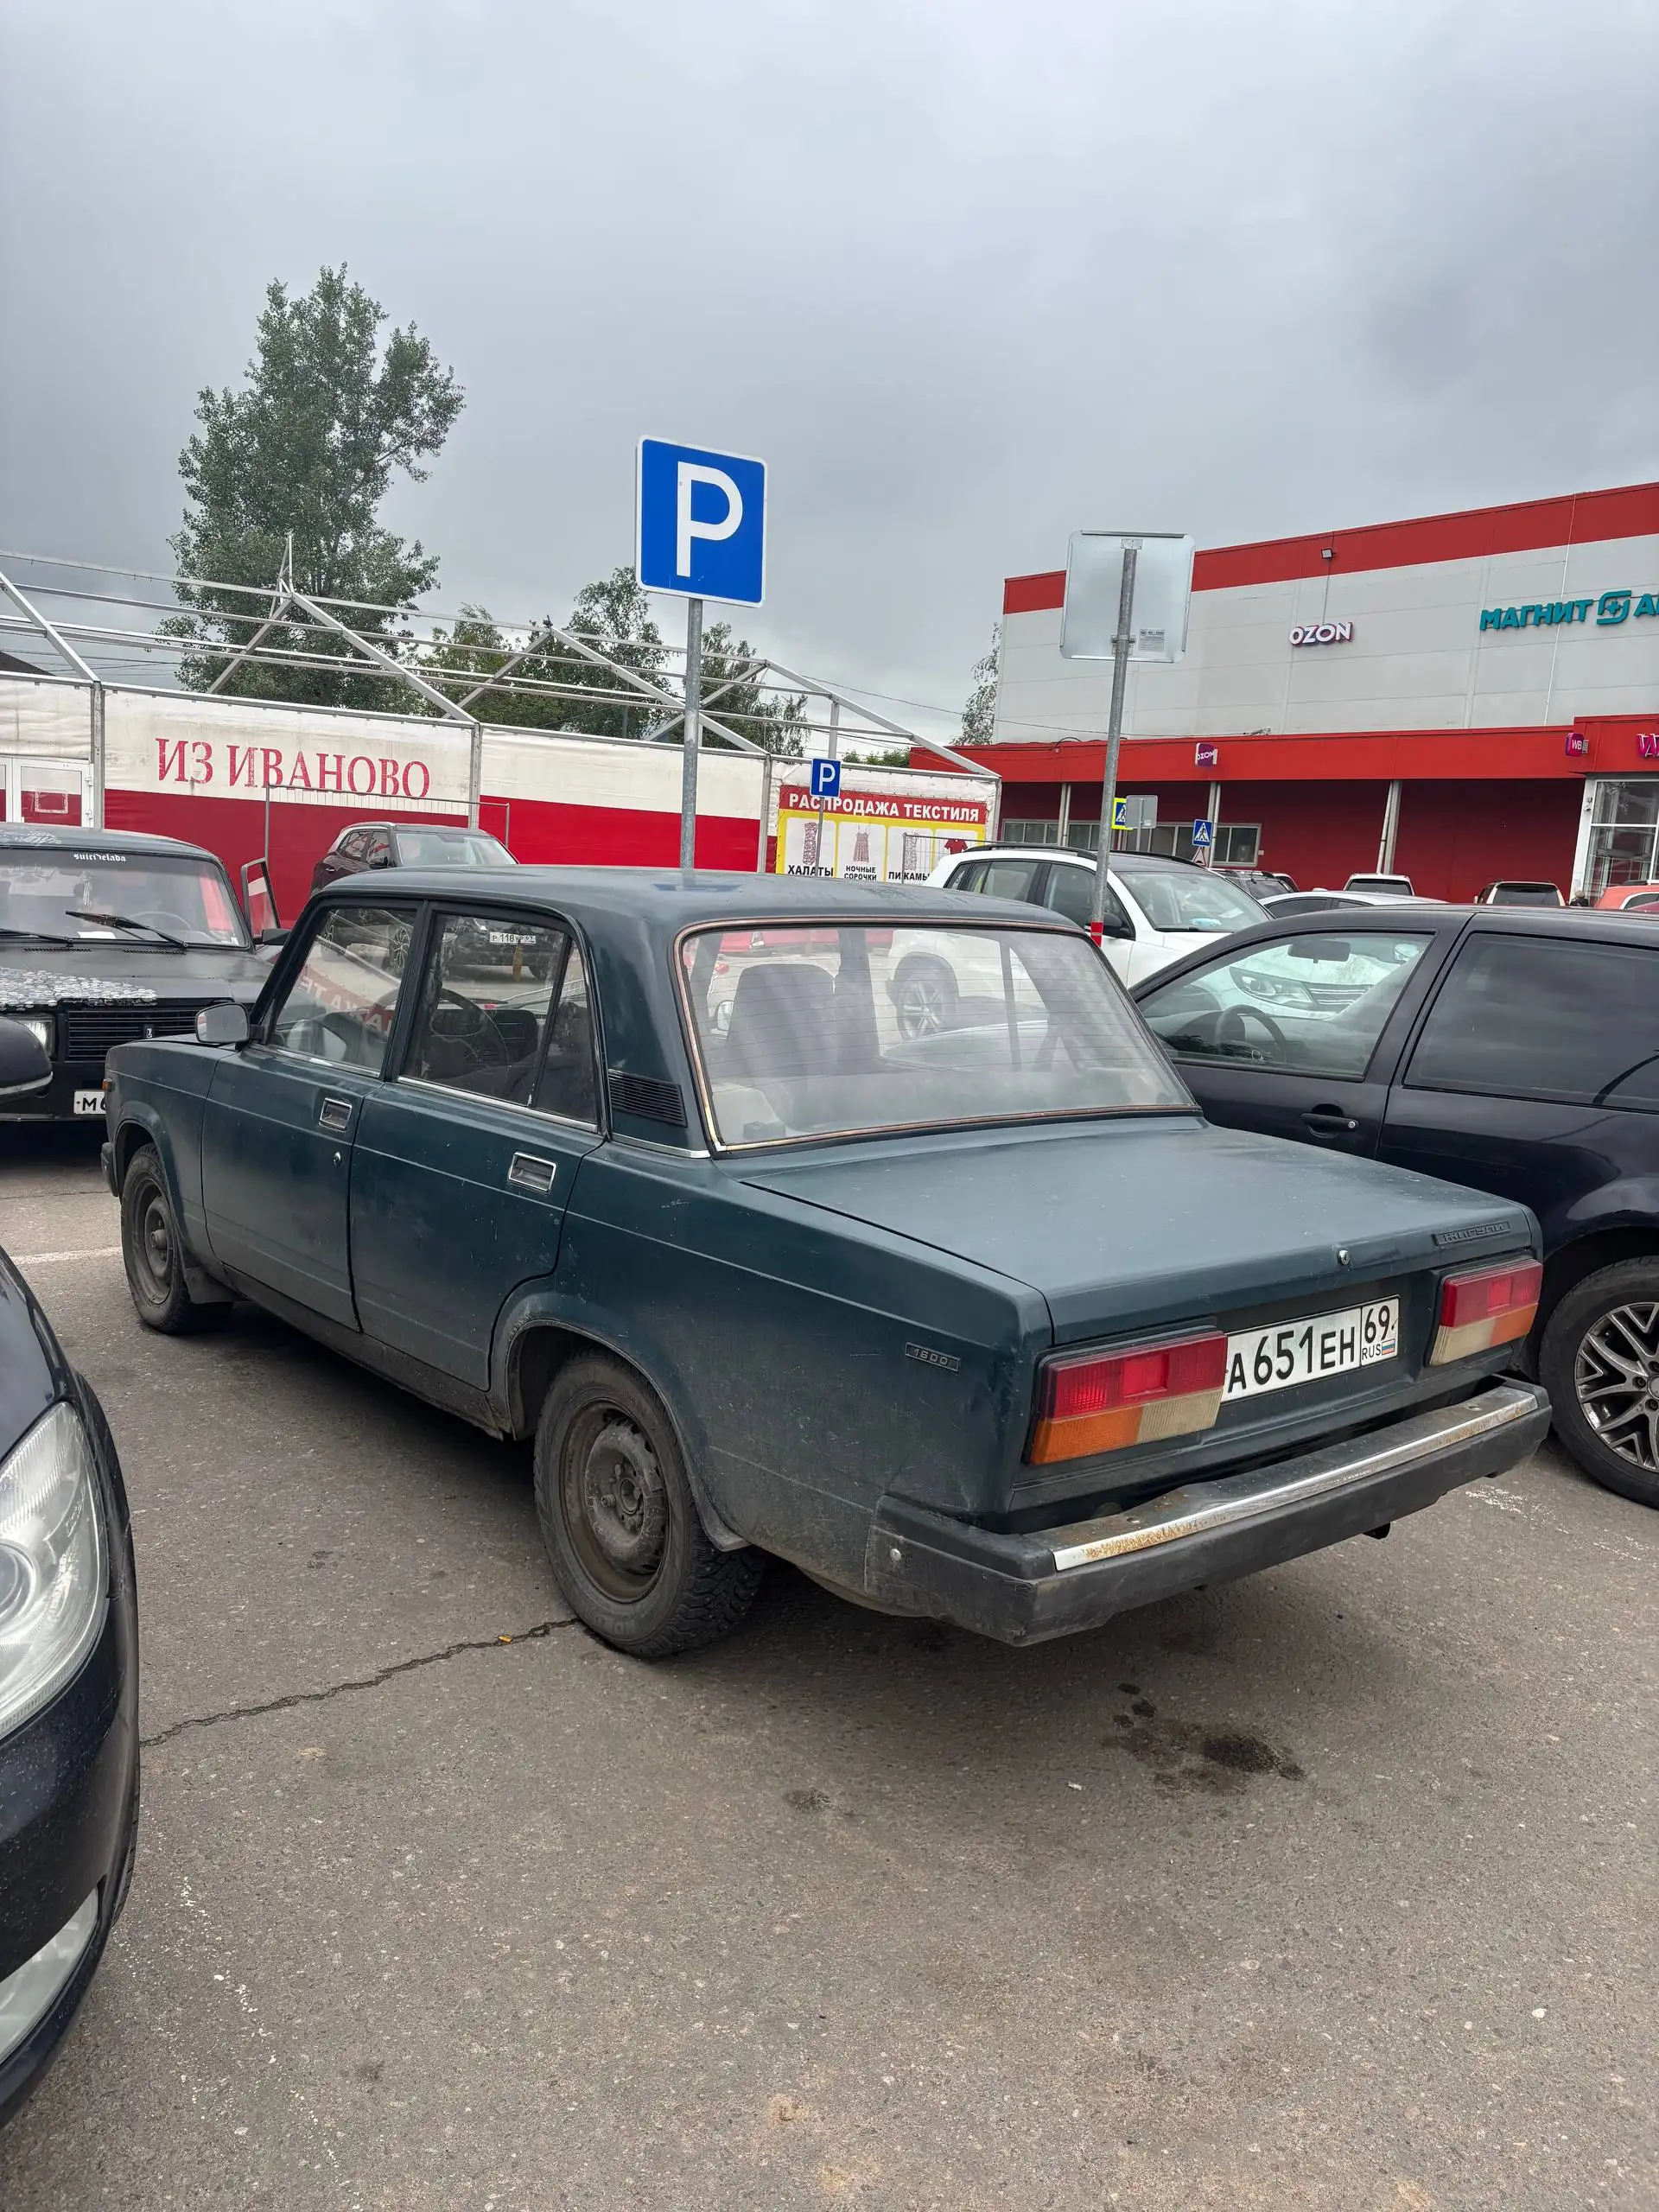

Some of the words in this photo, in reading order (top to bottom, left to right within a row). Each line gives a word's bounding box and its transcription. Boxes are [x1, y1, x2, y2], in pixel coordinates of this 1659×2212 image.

[677, 461, 743, 577] P
[1479, 599, 1593, 630] МАГНИТ
[1633, 593, 1659, 617] А
[1289, 622, 1353, 645] OZON
[1572, 740, 1582, 750] WB
[156, 738, 213, 785] ИЗ
[226, 745, 430, 800] ИВАНОВО
[819, 763, 836, 792] P
[789, 793, 899, 817] РАСПРОДАЖА
[904, 804, 979, 822] ТЕКСТИЛЯ
[788, 865, 834, 876] ХАЛАТЫ
[914, 1348, 948, 1365] 1600
[1228, 1325, 1355, 1393] А651ЕН
[1364, 1305, 1390, 1344] 69
[1362, 1343, 1382, 1360] RUS
